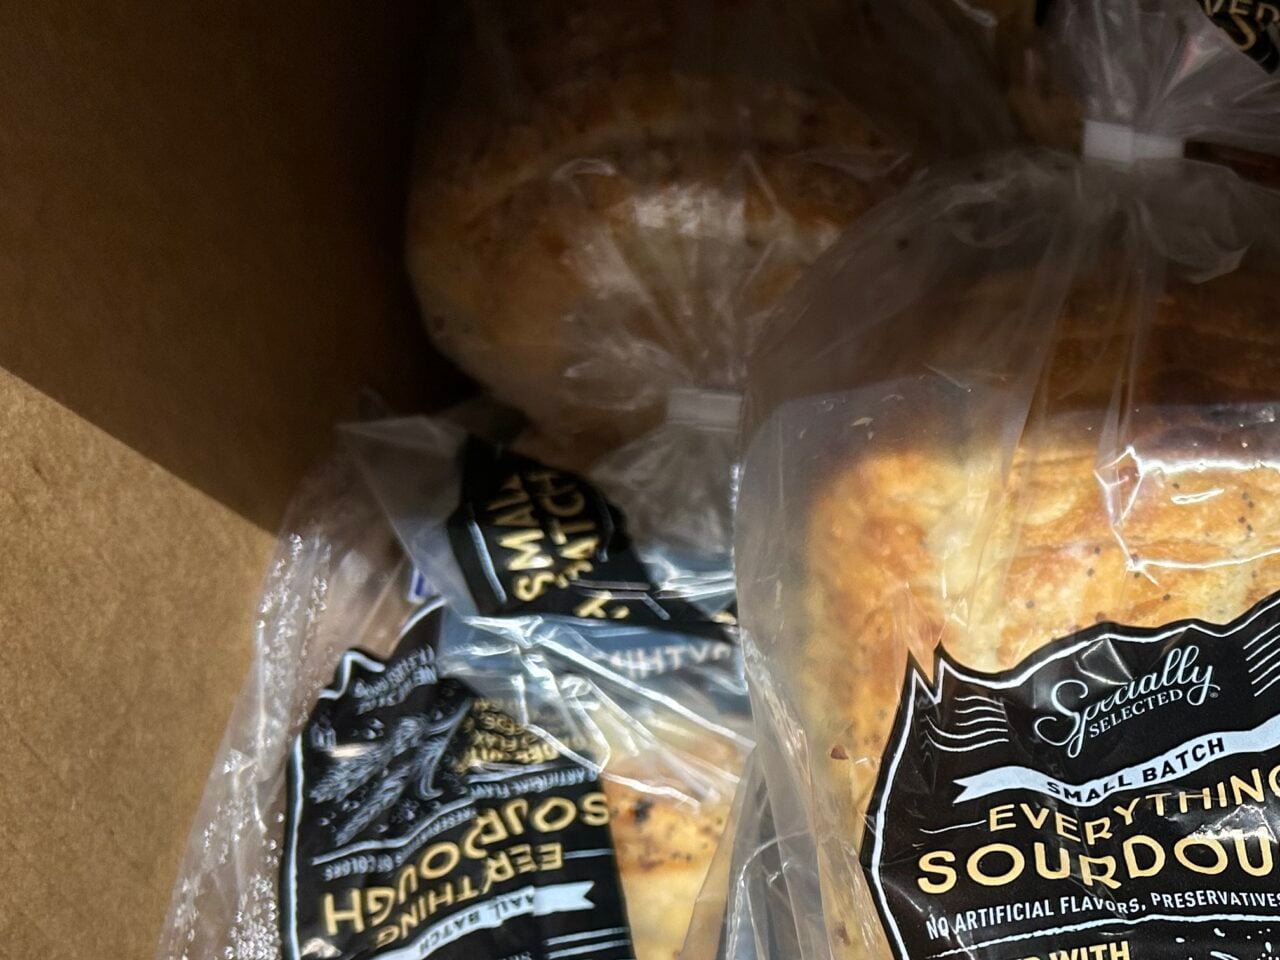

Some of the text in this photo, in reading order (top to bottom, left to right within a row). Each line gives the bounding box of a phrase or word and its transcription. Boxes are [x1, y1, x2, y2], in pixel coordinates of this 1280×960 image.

[1034, 645, 1218, 758] Specially
[1089, 689, 1183, 739] SELECTED
[1046, 736, 1225, 804] SMALL BATCH
[926, 918, 949, 940] NO
[954, 900, 1055, 937] ARTIFICIAL
[1061, 896, 1147, 915] FLAVORS,
